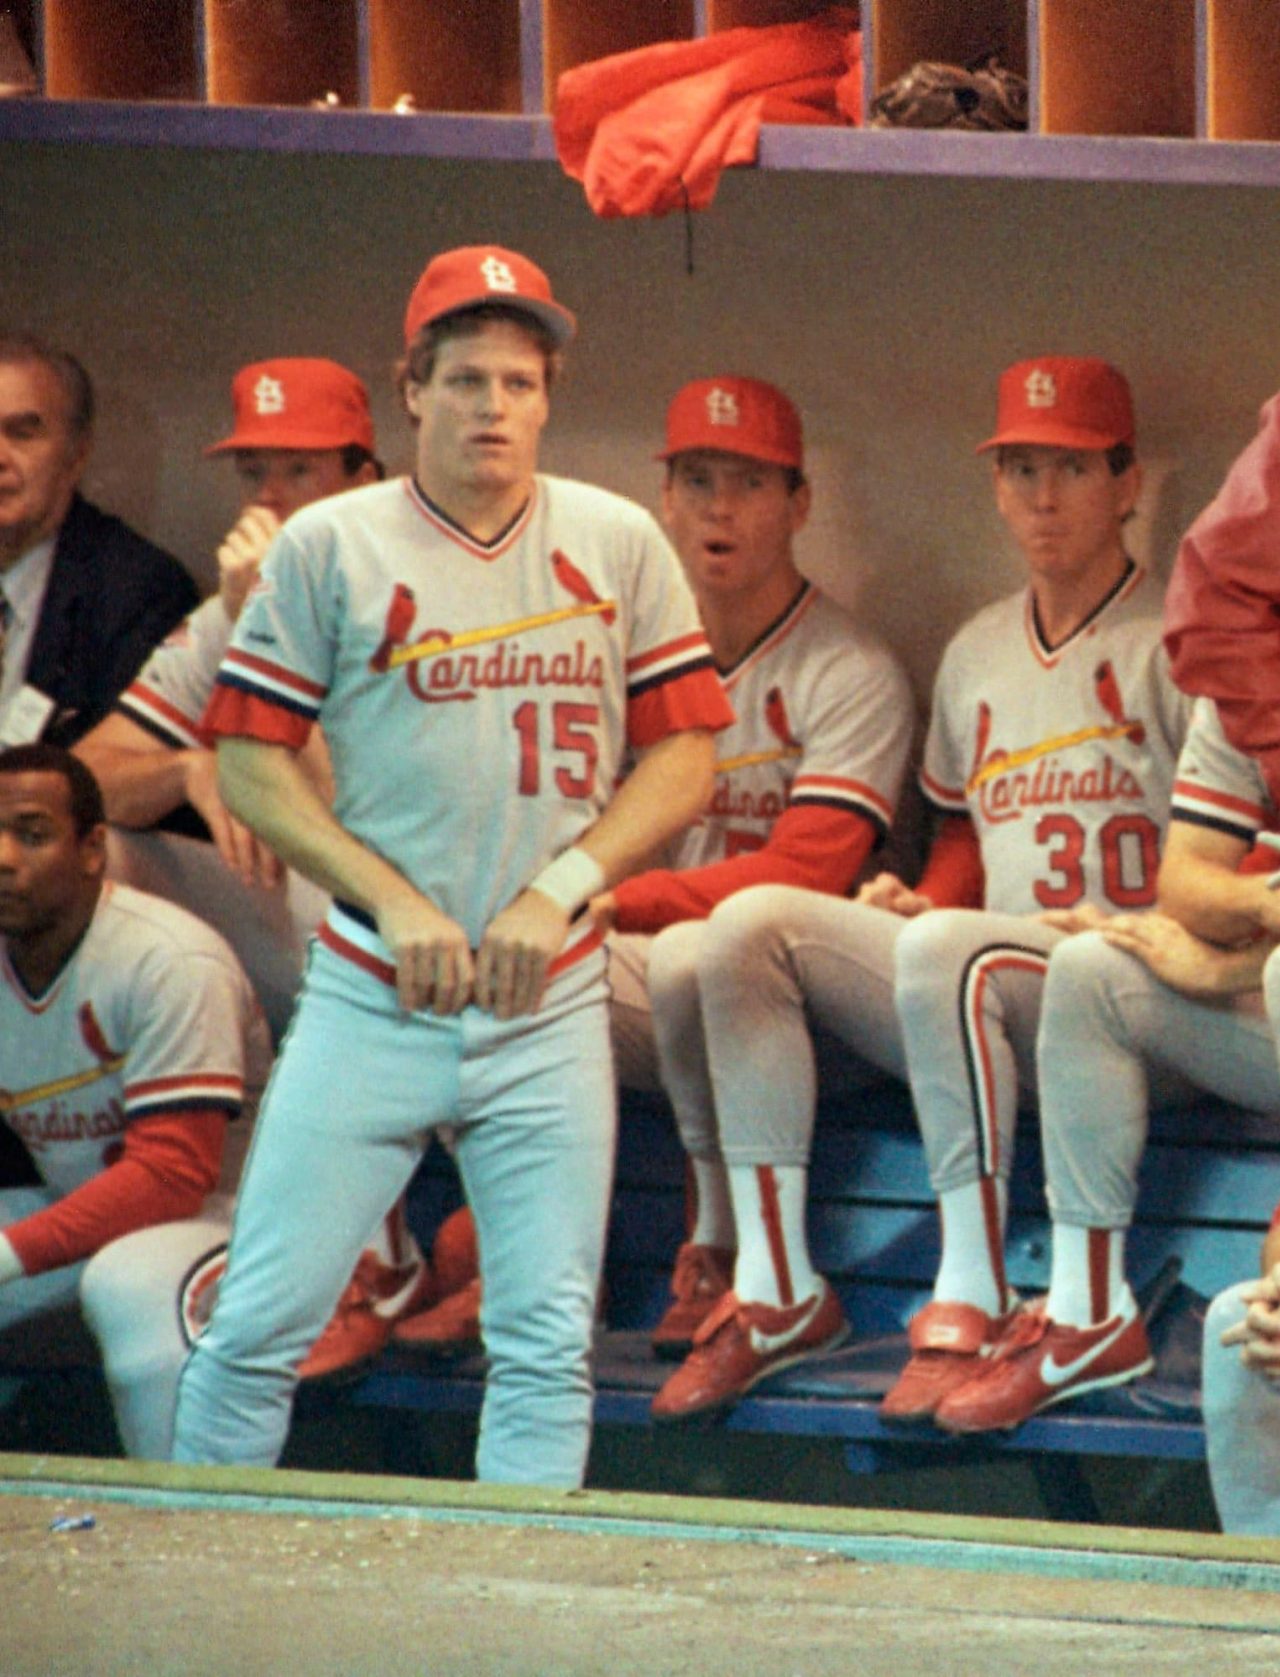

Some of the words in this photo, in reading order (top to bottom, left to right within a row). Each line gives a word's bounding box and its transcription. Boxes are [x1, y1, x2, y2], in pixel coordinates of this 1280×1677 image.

[406, 628, 604, 703] Cardinals
[512, 701, 600, 799] 15
[981, 747, 1145, 825] Cardinals
[1033, 812, 1162, 910] 30
